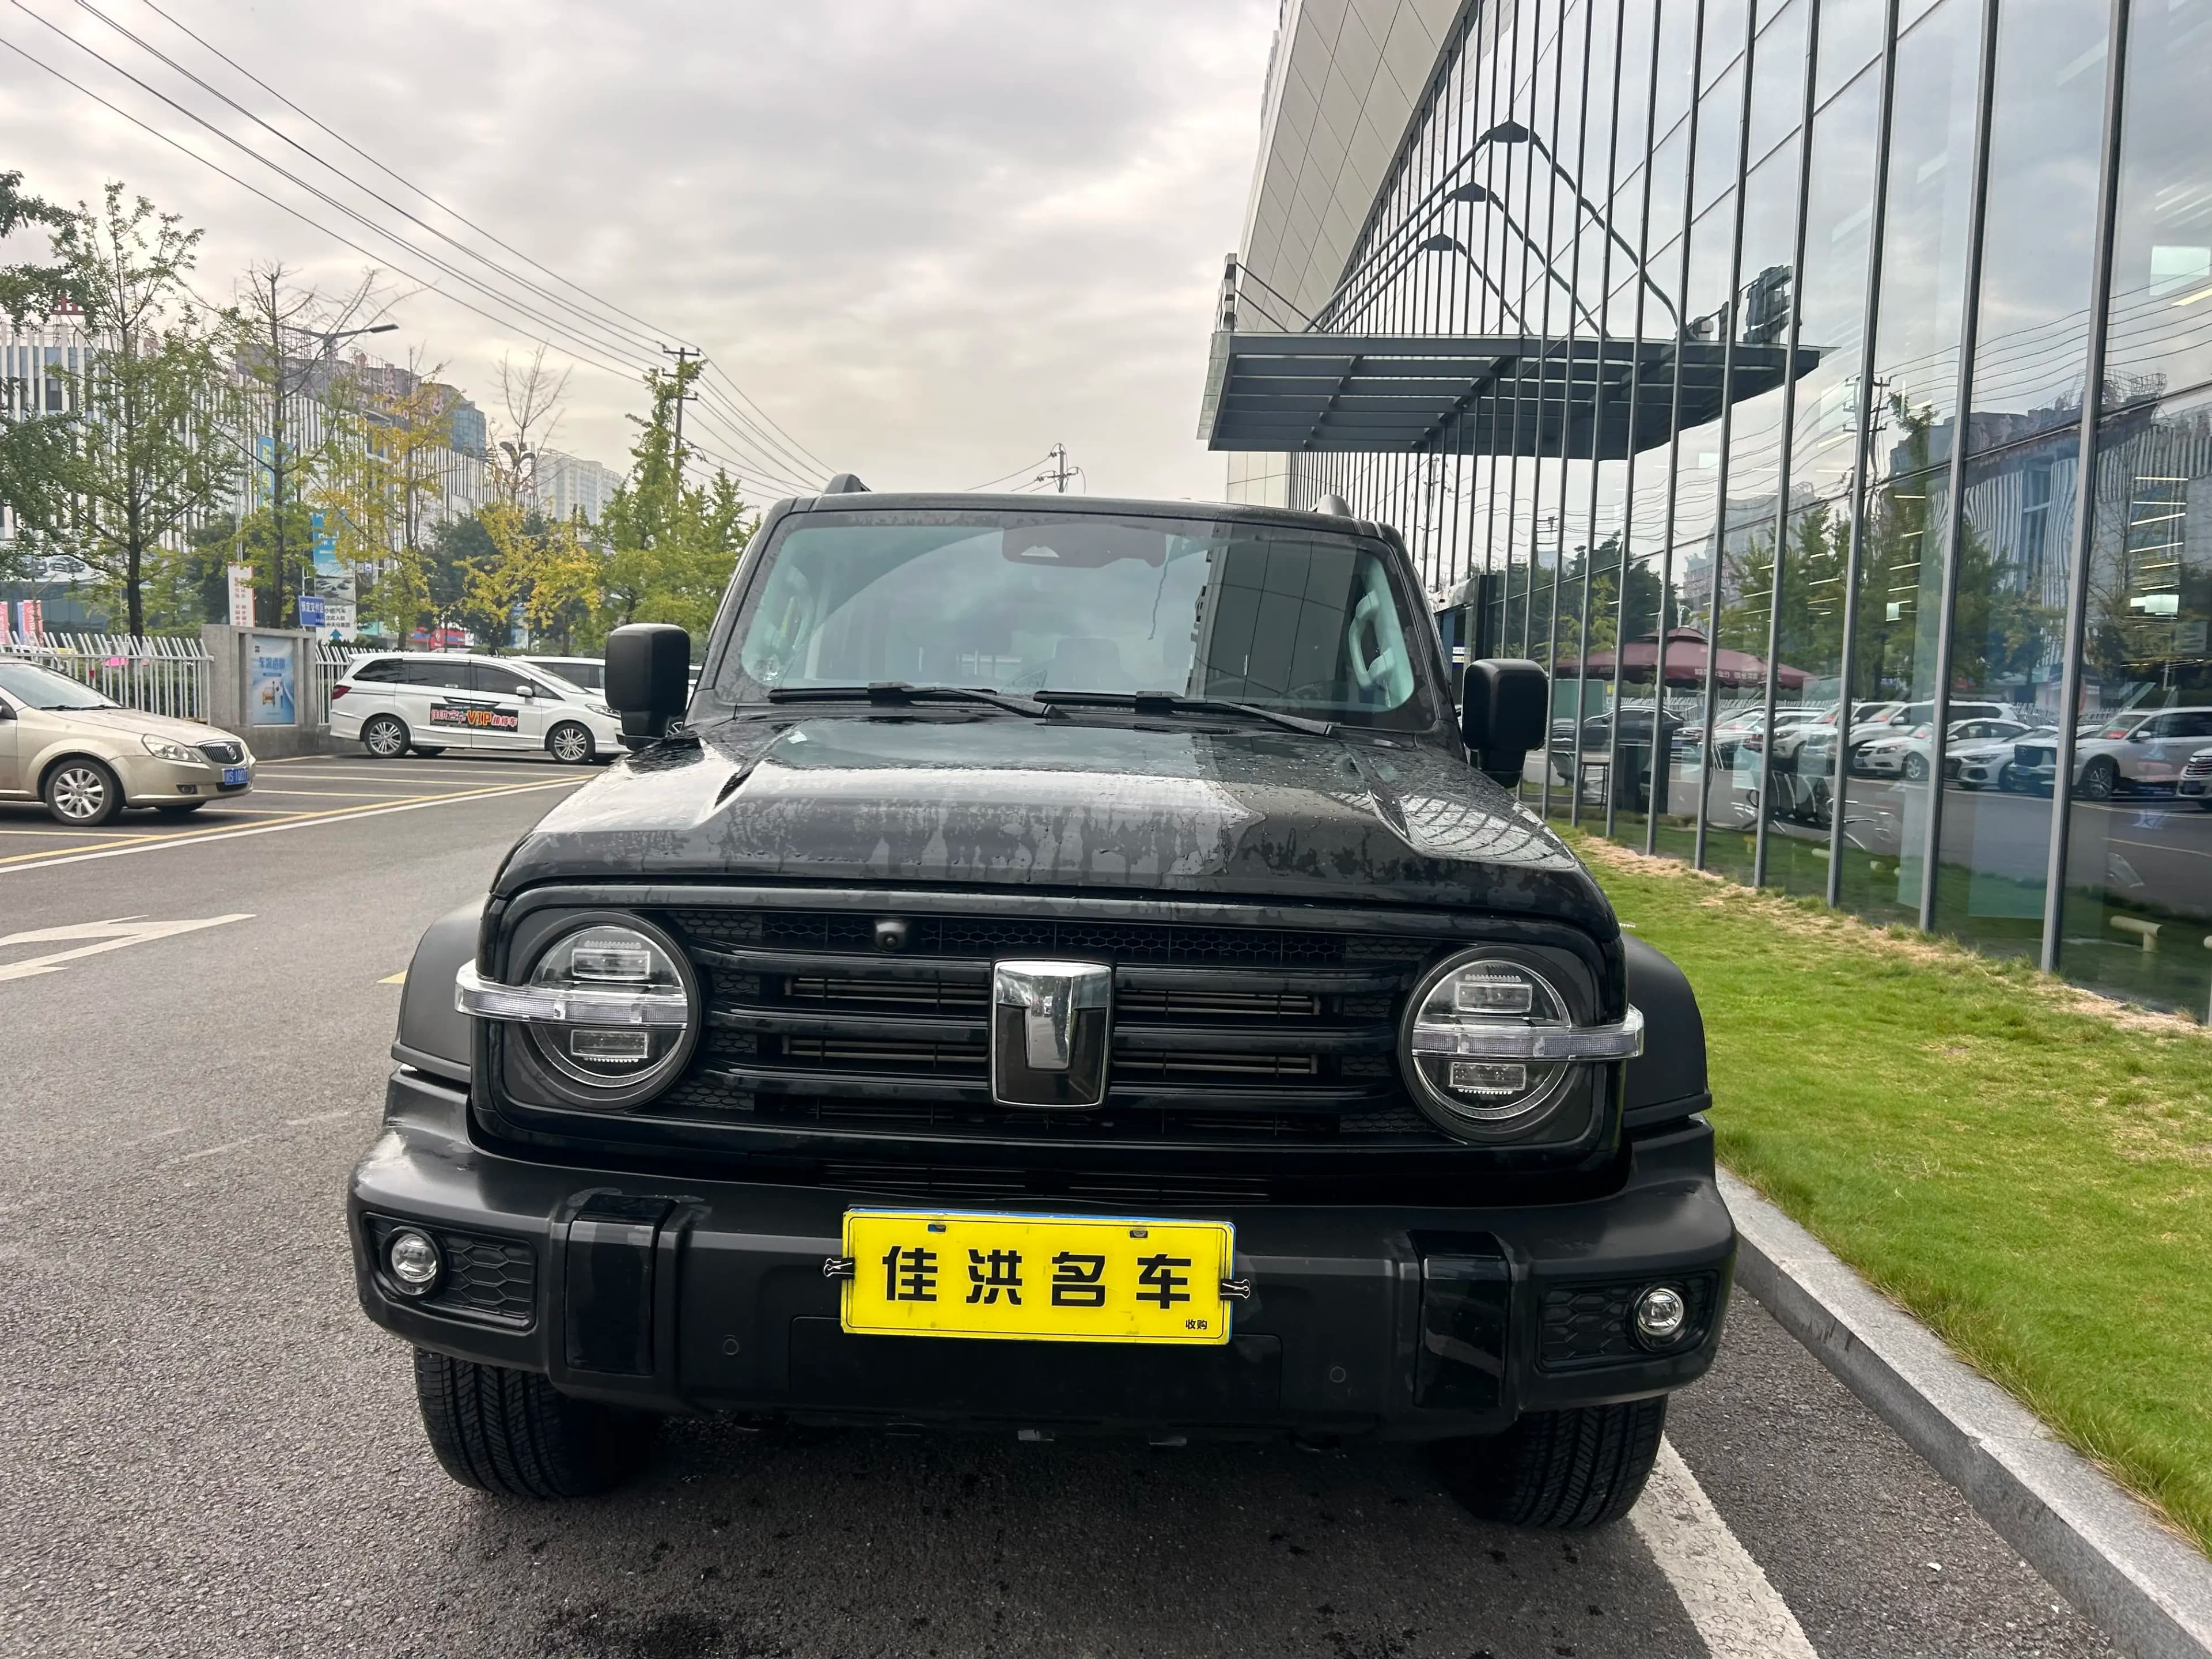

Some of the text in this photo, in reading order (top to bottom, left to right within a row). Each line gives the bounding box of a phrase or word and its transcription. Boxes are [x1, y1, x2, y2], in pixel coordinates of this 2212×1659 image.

[882, 1245, 1193, 1310] 佳洪名车
[1185, 1319, 1208, 1330] 收购
